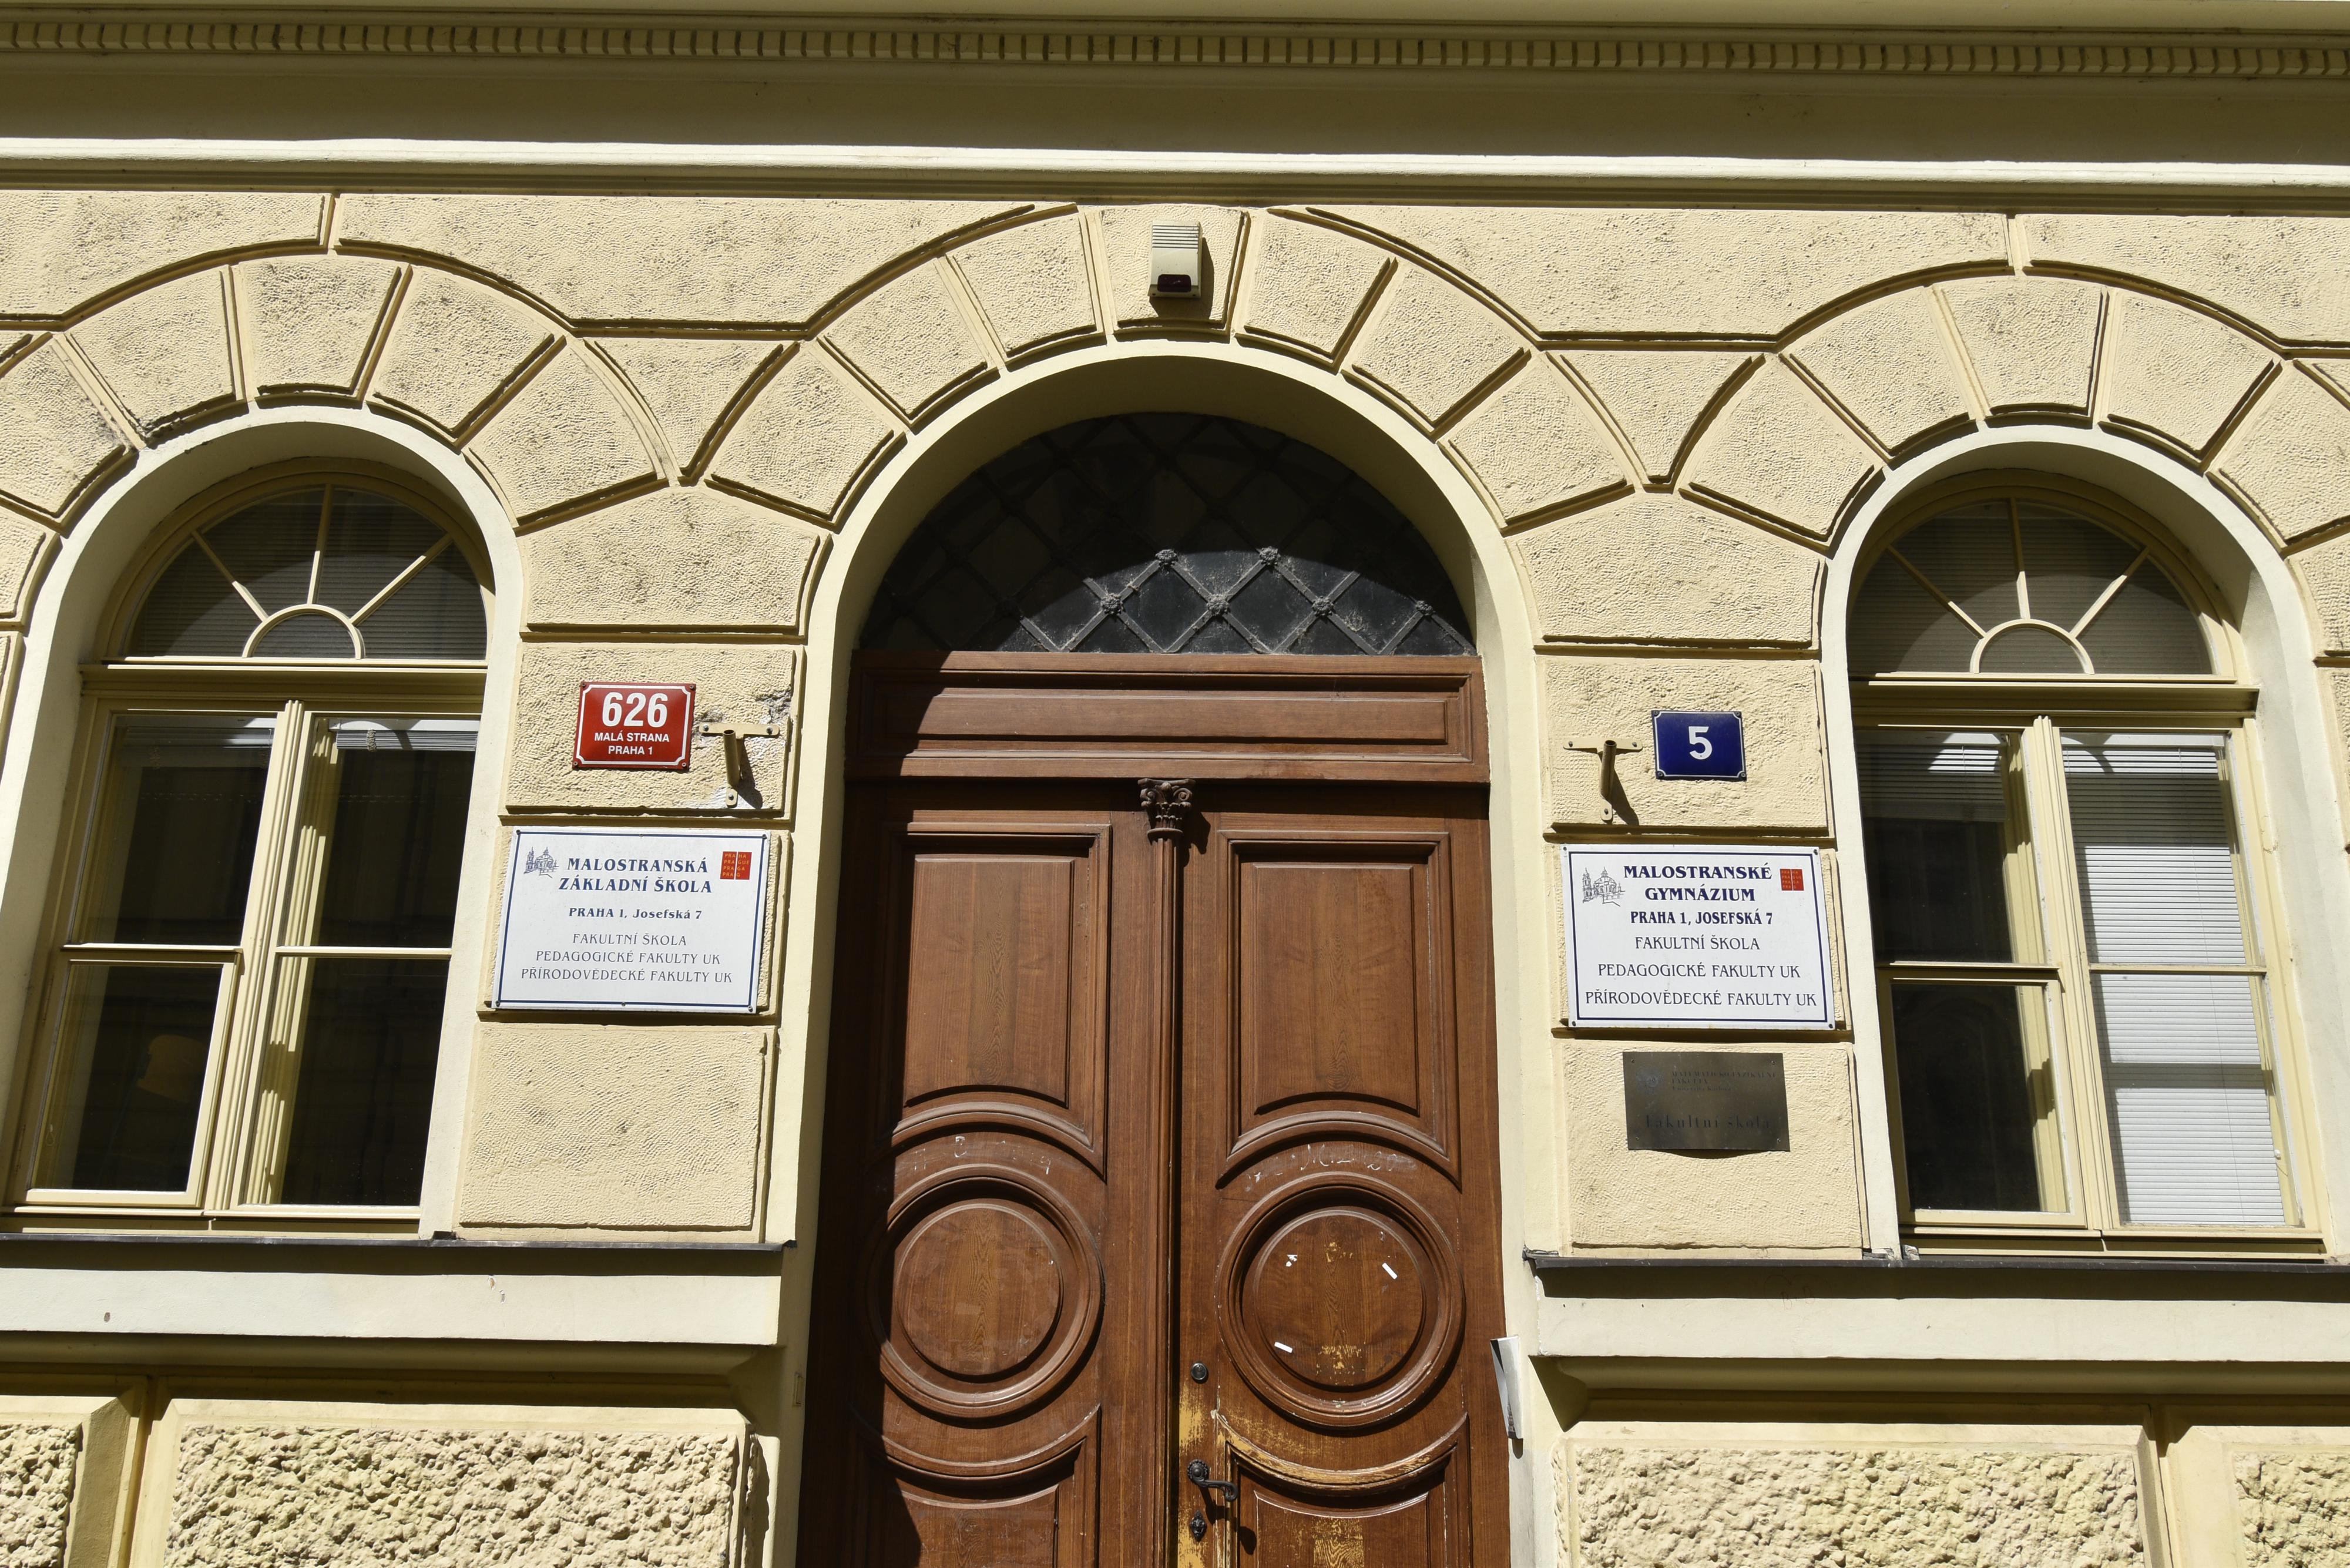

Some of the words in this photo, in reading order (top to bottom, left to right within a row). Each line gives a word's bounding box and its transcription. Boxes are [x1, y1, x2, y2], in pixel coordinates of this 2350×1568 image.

[602, 691, 668, 728] 626
[594, 732, 624, 741] MALÁ
[626, 732, 670, 743] STRANA
[1688, 726, 1713, 760] 5
[608, 745, 645, 755] PRAHA
[648, 746, 653, 755] 1
[567, 857, 708, 873] MALOSTRANSKÁ
[1623, 862, 1772, 879] MALOSTRANSKÉ
[558, 875, 649, 892] ZÁKLADNÍ
[654, 877, 711, 893] ŠKOLA
[1644, 883, 1755, 901] GYMNÁZIUM
[569, 908, 614, 918] PRAHA
[619, 909, 627, 919] 1,
[632, 909, 690, 919] Josefská
[695, 910, 702, 919] 7
[1630, 911, 1676, 924] PRAHA
[1680, 912, 1691, 926] 1,
[1695, 908, 1762, 925] JOSEFSKÁ
[1765, 912, 1772, 925] 7
[573, 932, 638, 945] FAKULTNÍ
[642, 933, 687, 946] ŠKOLA
[1635, 934, 1705, 949] FAKULTNÍ
[1710, 935, 1760, 950] ŠKOLA
[536, 951, 633, 963] PEDAGOGICKÉ
[639, 952, 698, 964] FAKULTY
[703, 954, 720, 965] UK
[521, 966, 645, 981] PŘÍRODOVĚDECKÉ
[650, 971, 710, 982] FAKULTY
[714, 972, 732, 983] UK
[1598, 961, 1706, 977] PEDAGOGICKÉ
[1711, 965, 1775, 978] FAKULTY
[1780, 965, 1801, 978] UK
[1585, 989, 1722, 1005] PŘÍRODOVĚDECKÉ
[1727, 993, 1791, 1006] FAKULTY
[1796, 993, 1817, 1006] UK
